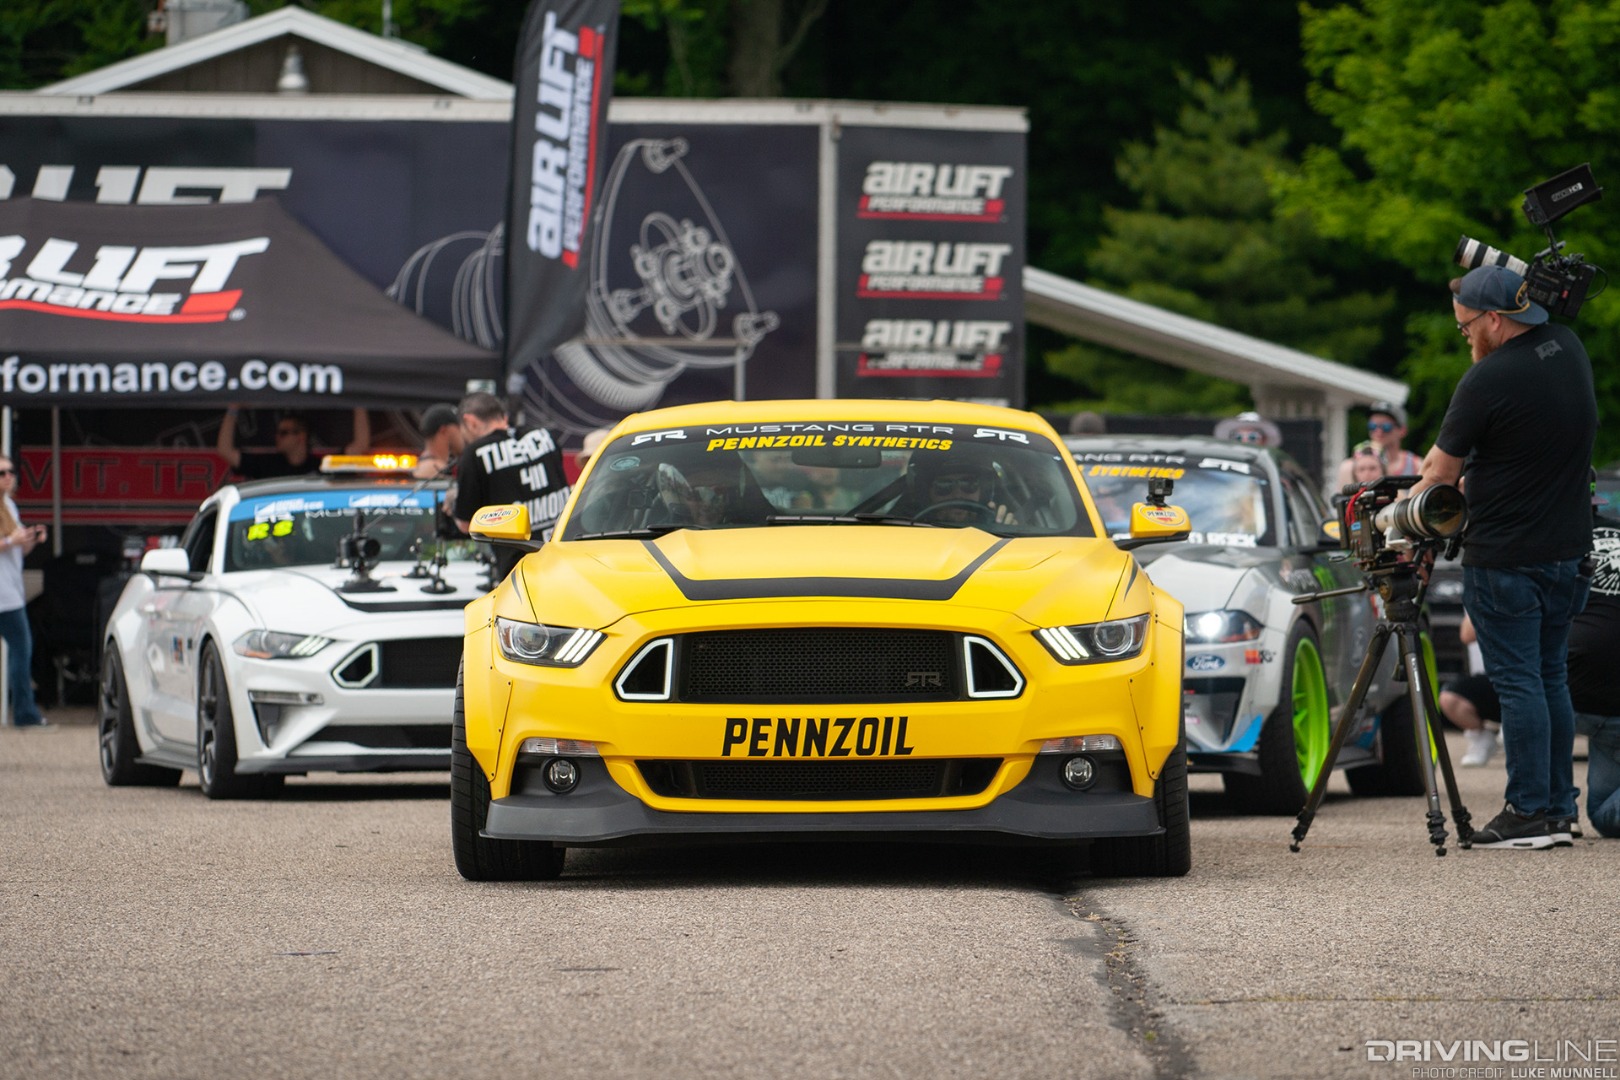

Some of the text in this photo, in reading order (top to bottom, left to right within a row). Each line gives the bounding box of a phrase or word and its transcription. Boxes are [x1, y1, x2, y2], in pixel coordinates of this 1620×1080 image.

[26, 236, 270, 294] LIFT
[706, 424, 954, 436] MUSTANG RTR
[706, 434, 953, 452] PENNZOIL SYNTHETICS
[519, 462, 549, 491] 411
[721, 716, 916, 757] PENNZOIL
